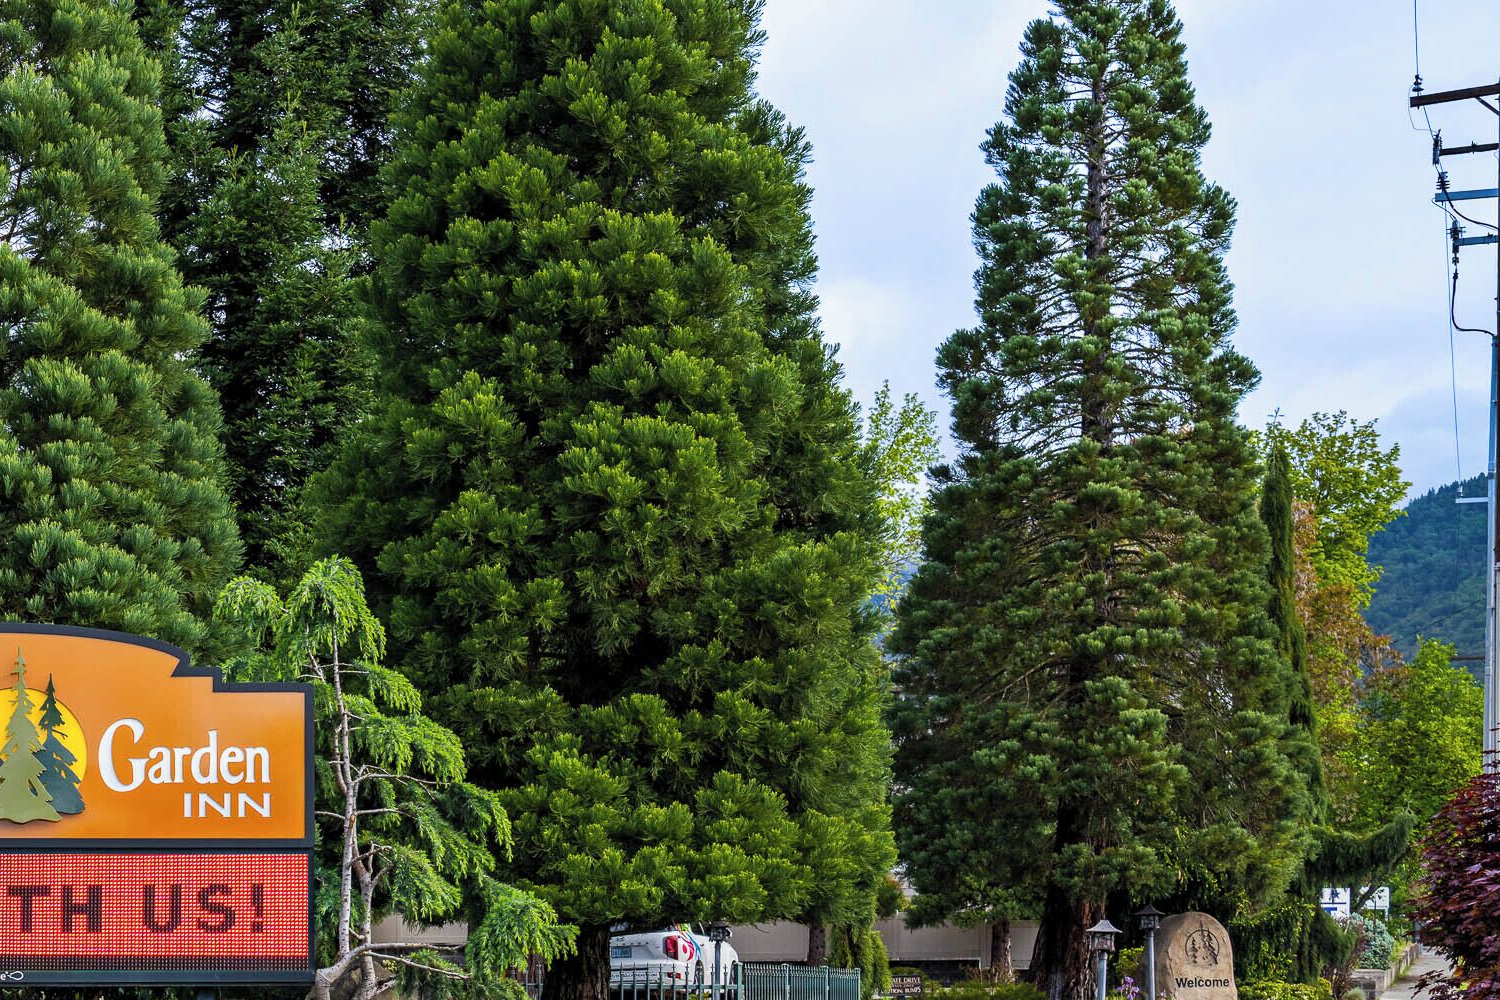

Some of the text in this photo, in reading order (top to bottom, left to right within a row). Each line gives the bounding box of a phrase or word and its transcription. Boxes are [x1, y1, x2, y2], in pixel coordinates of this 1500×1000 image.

[98, 718, 271, 793] Garden
[183, 792, 271, 818] INN
[142, 884, 265, 934] US!
[1175, 977, 1230, 988] Welcome
